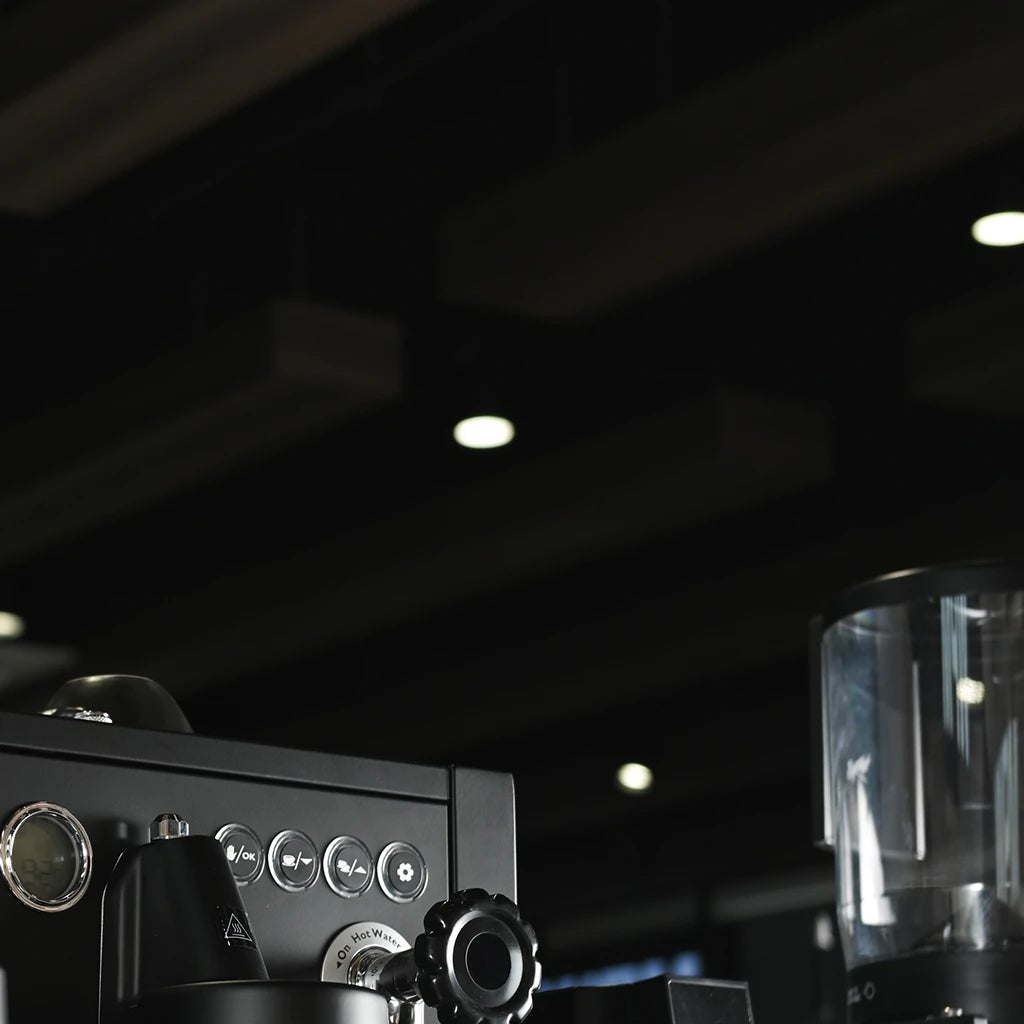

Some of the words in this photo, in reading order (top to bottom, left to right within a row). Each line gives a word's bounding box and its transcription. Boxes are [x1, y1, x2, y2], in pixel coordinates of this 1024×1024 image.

[337, 944, 351, 960] On
[351, 930, 371, 943] Hot
[371, 928, 401, 948] Water
